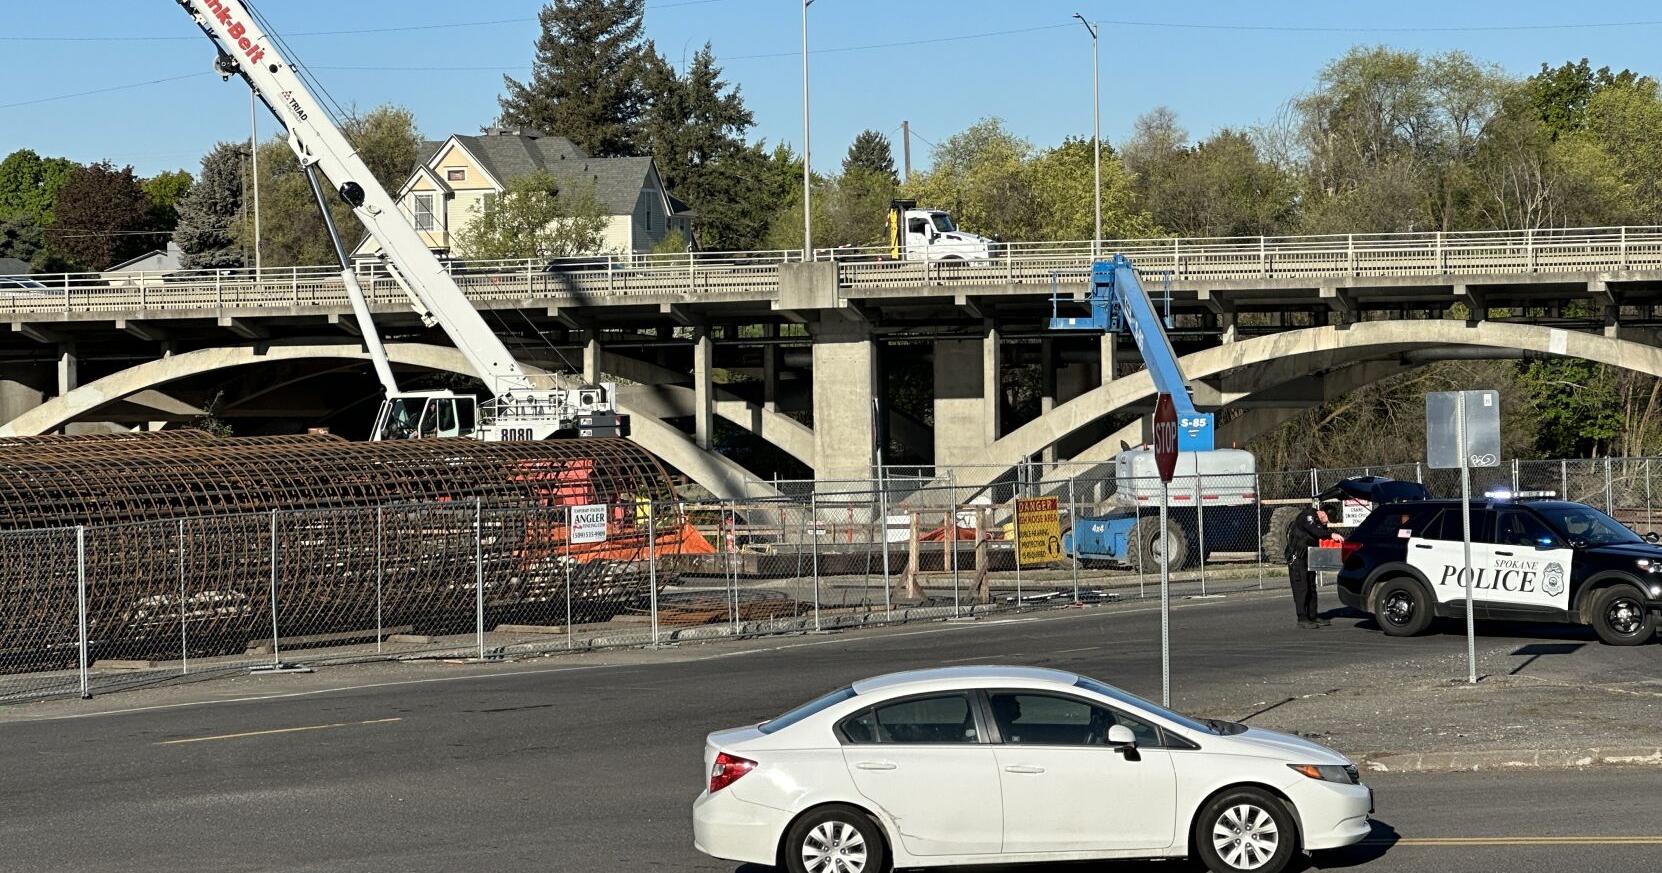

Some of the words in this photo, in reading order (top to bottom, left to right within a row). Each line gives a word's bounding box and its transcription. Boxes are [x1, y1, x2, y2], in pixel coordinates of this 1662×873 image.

[204, 0, 265, 65] nk-Belt
[289, 98, 308, 121] TRIAD
[1181, 418, 1207, 428] S-85
[1155, 421, 1177, 454] STOP
[1018, 500, 1053, 512] DANGER
[574, 513, 605, 524] ANGLER
[1045, 513, 1058, 522] AREA
[1091, 523, 1105, 533] 4x4
[1494, 560, 1539, 570] SPOKANE
[1439, 564, 1537, 593] POLICE
